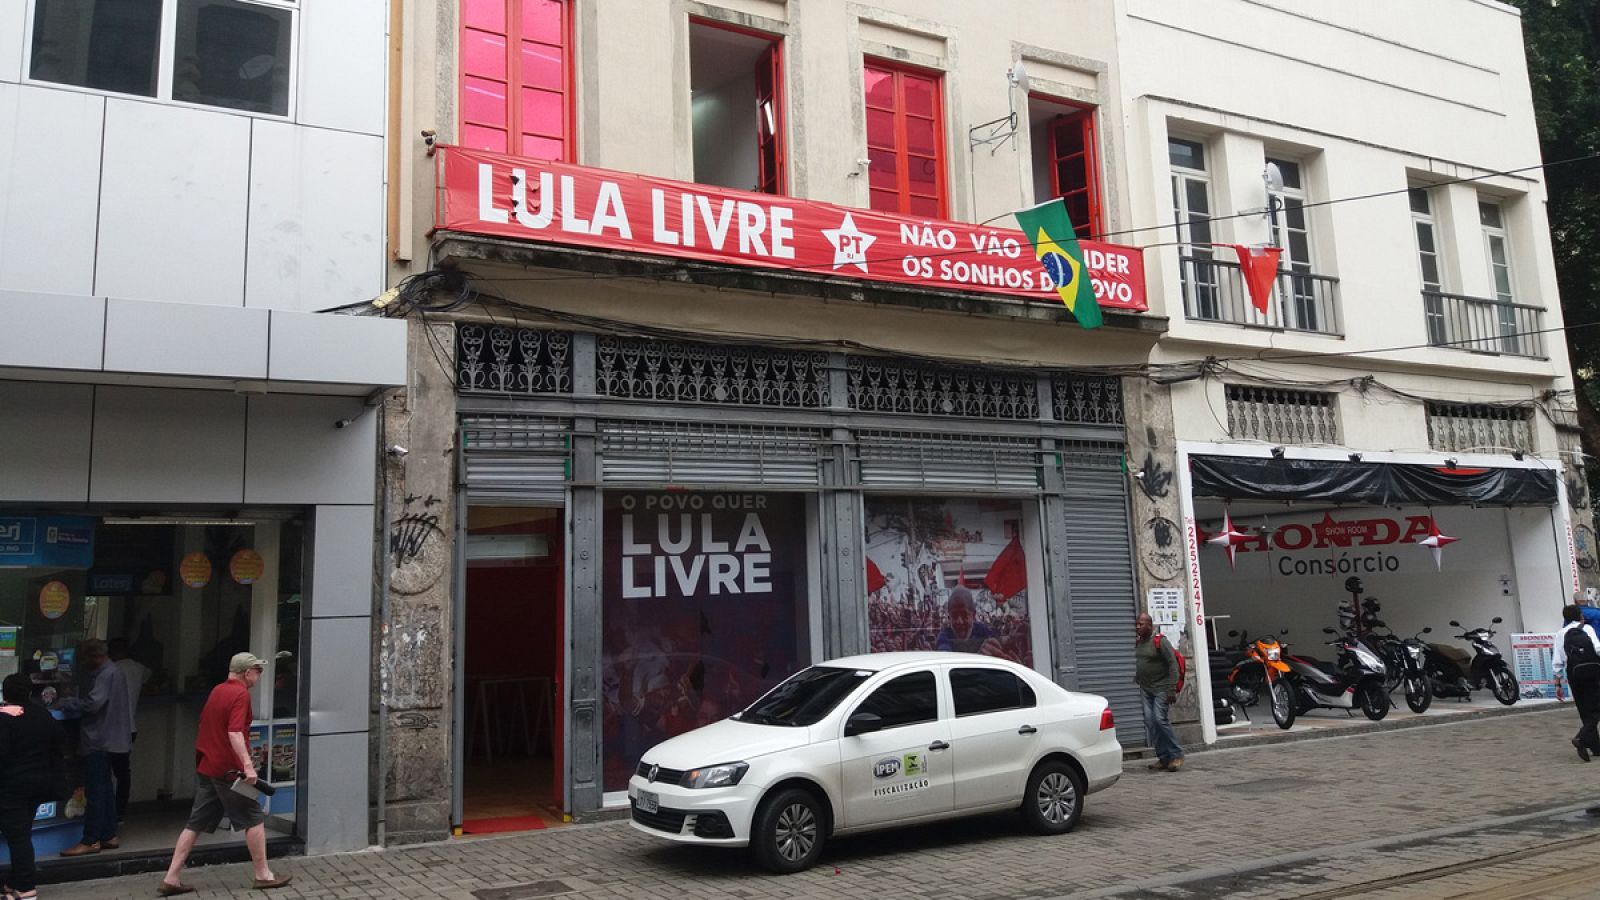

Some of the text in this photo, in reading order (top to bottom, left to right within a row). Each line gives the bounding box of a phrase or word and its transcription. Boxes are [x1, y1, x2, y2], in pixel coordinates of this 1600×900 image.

[478, 163, 796, 260] LULA LIVRE
[839, 234, 863, 254] PT
[900, 222, 957, 250] NÃO
[969, 230, 1021, 259] VÃO
[902, 255, 933, 279] OS
[940, 258, 1034, 291] SONHOS
[1091, 278, 1133, 303] OVO
[621, 494, 767, 511] O POVO QUER
[621, 512, 772, 555] LULA
[1324, 524, 1369, 536] SHOW ROOM
[621, 552, 773, 600] LIVRE
[1278, 551, 1400, 577] Consórcio
[876, 762, 898, 777] IPEM
